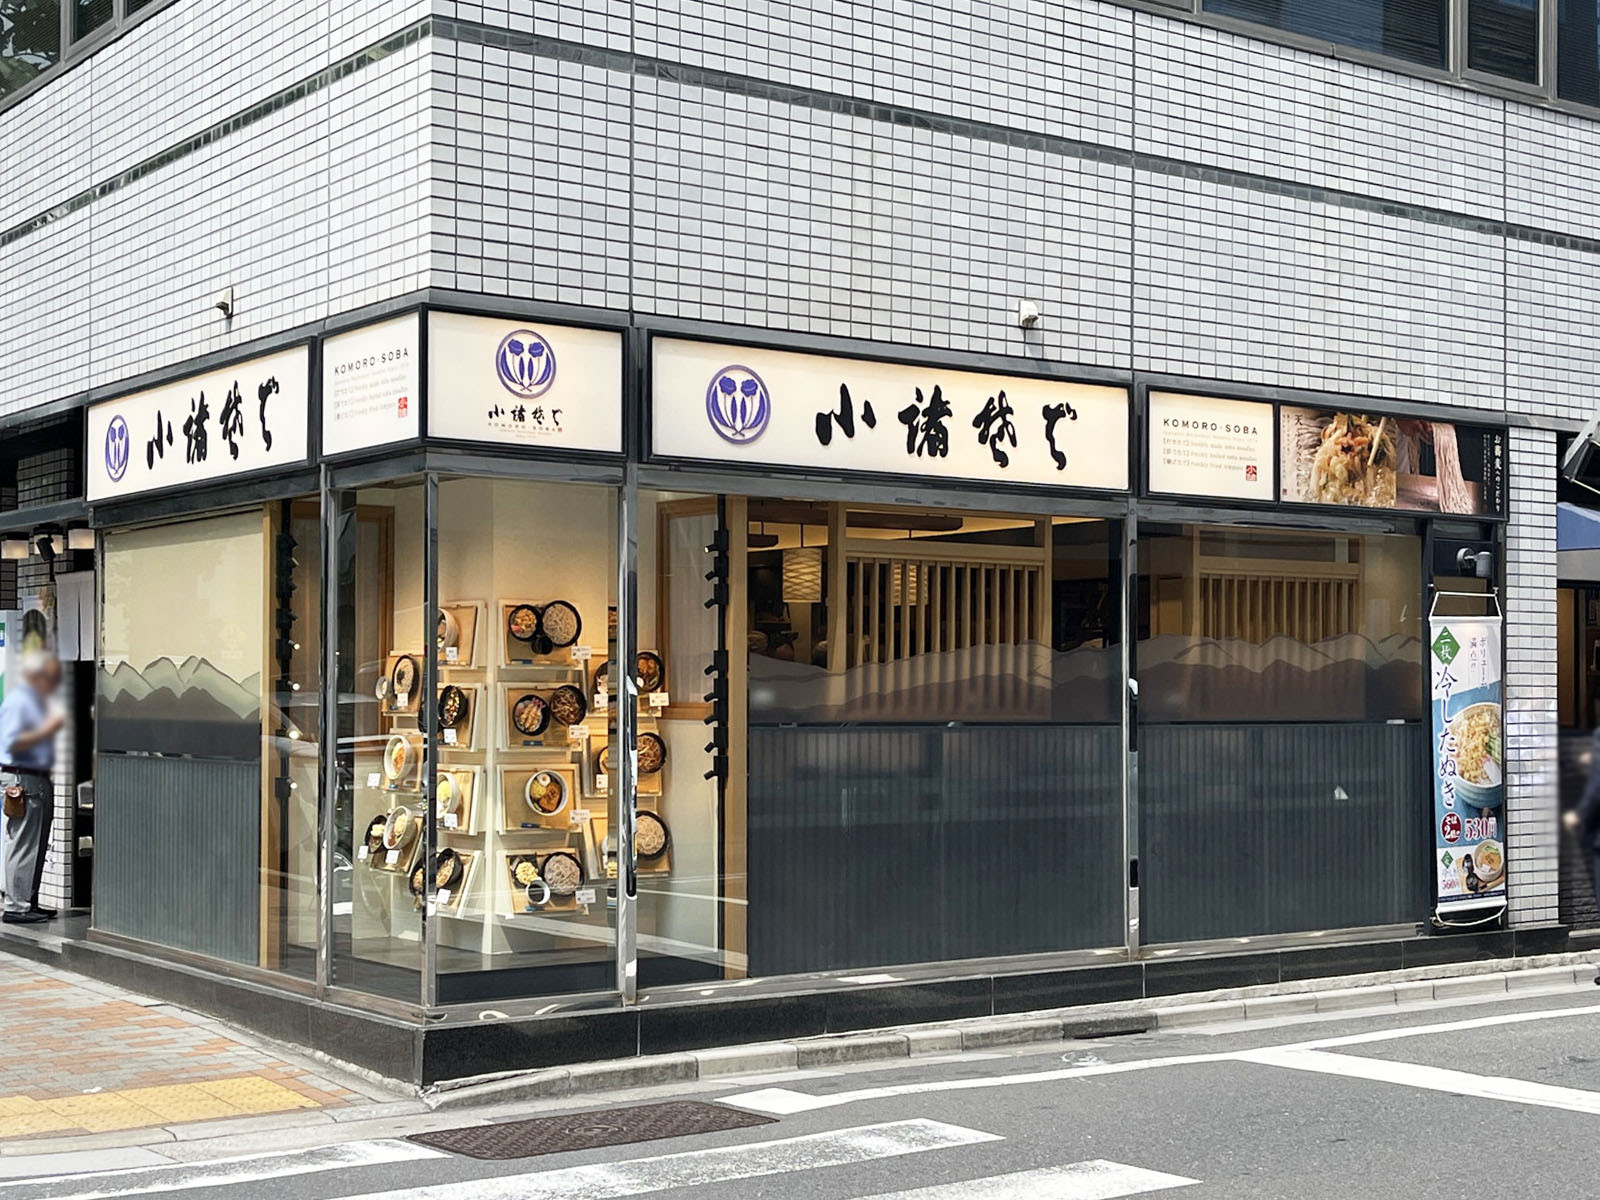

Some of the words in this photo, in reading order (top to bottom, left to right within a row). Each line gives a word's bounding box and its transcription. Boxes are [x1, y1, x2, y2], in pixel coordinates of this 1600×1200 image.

[1434, 665, 1459, 807] 冷したぬき
